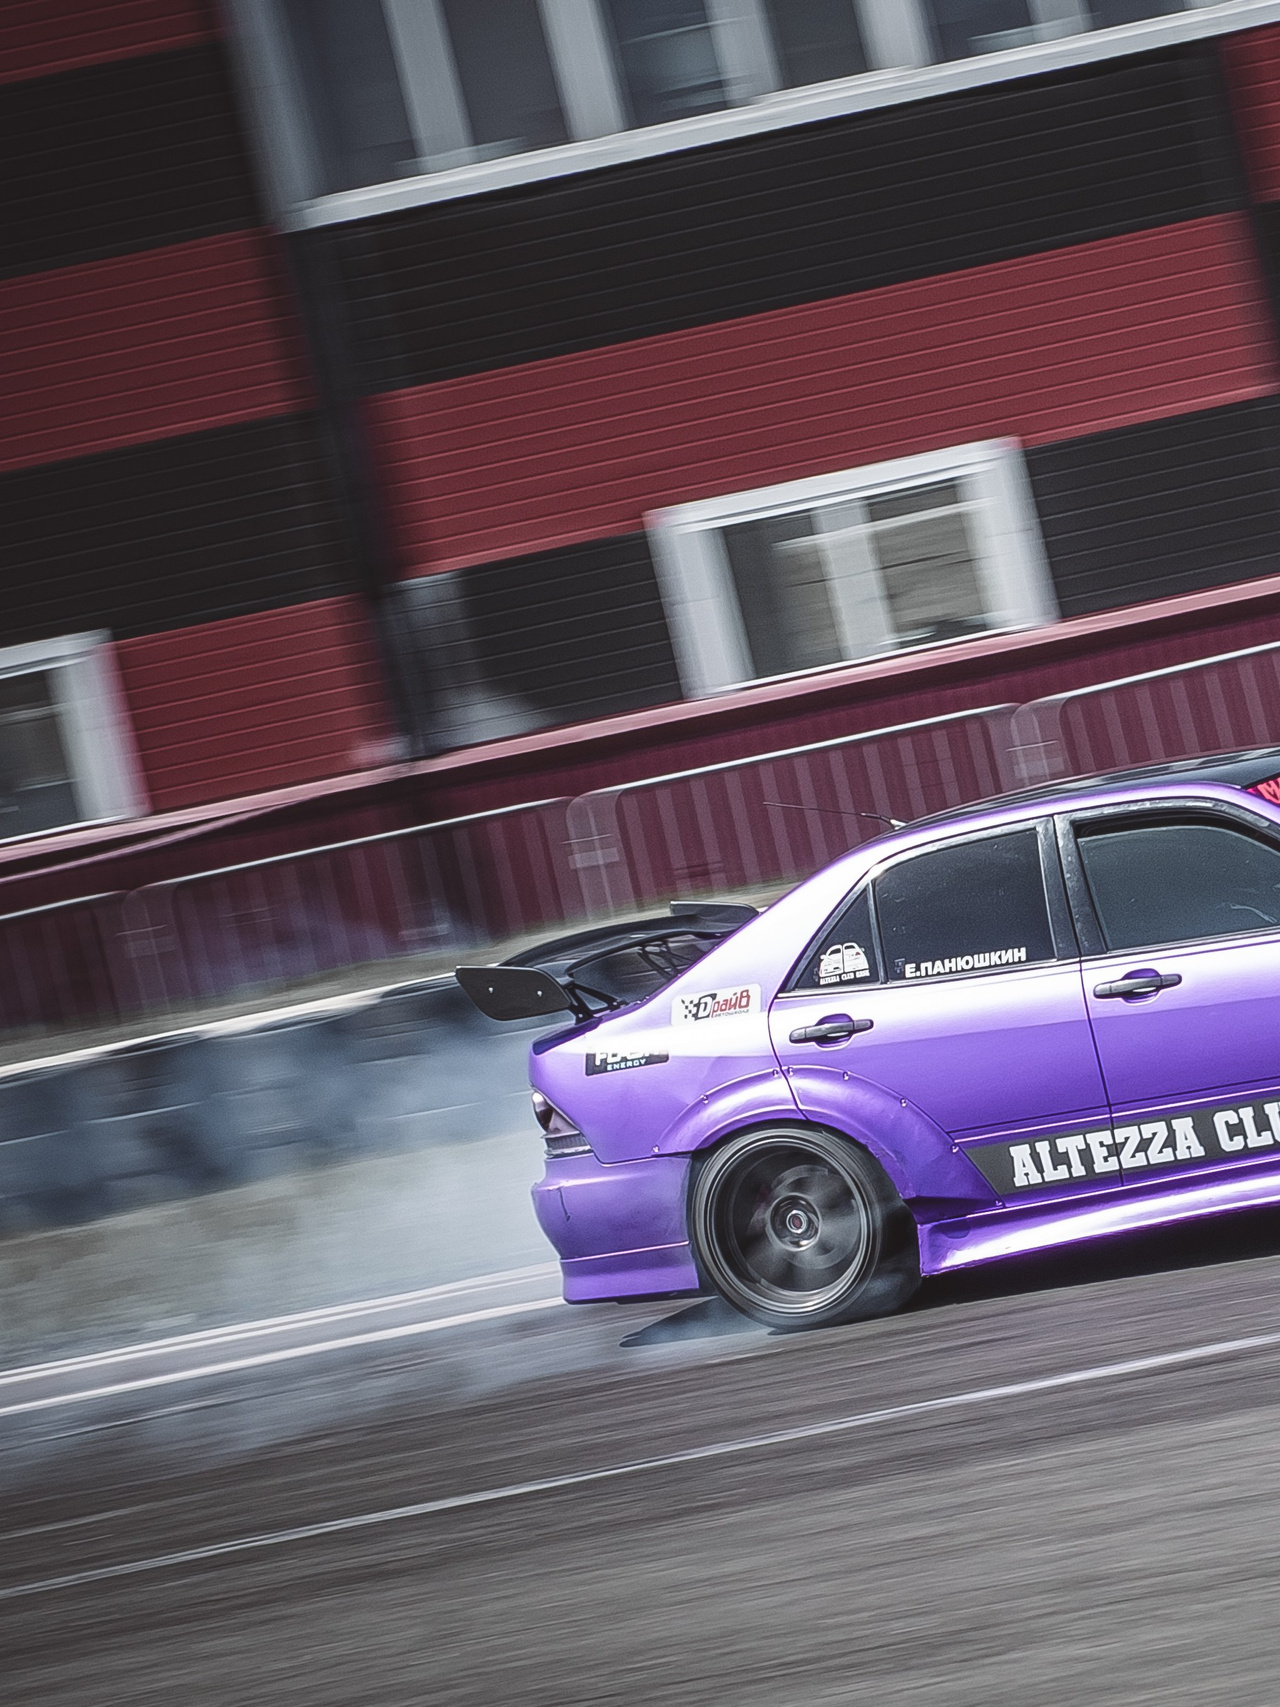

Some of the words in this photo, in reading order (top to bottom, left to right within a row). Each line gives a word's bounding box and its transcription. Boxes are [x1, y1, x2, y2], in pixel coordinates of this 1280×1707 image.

[904, 947, 1027, 979] Е.ПАНЮШКИН
[606, 1058, 647, 1071] ENERGY
[1008, 1115, 1205, 1187] ALTEZZA
